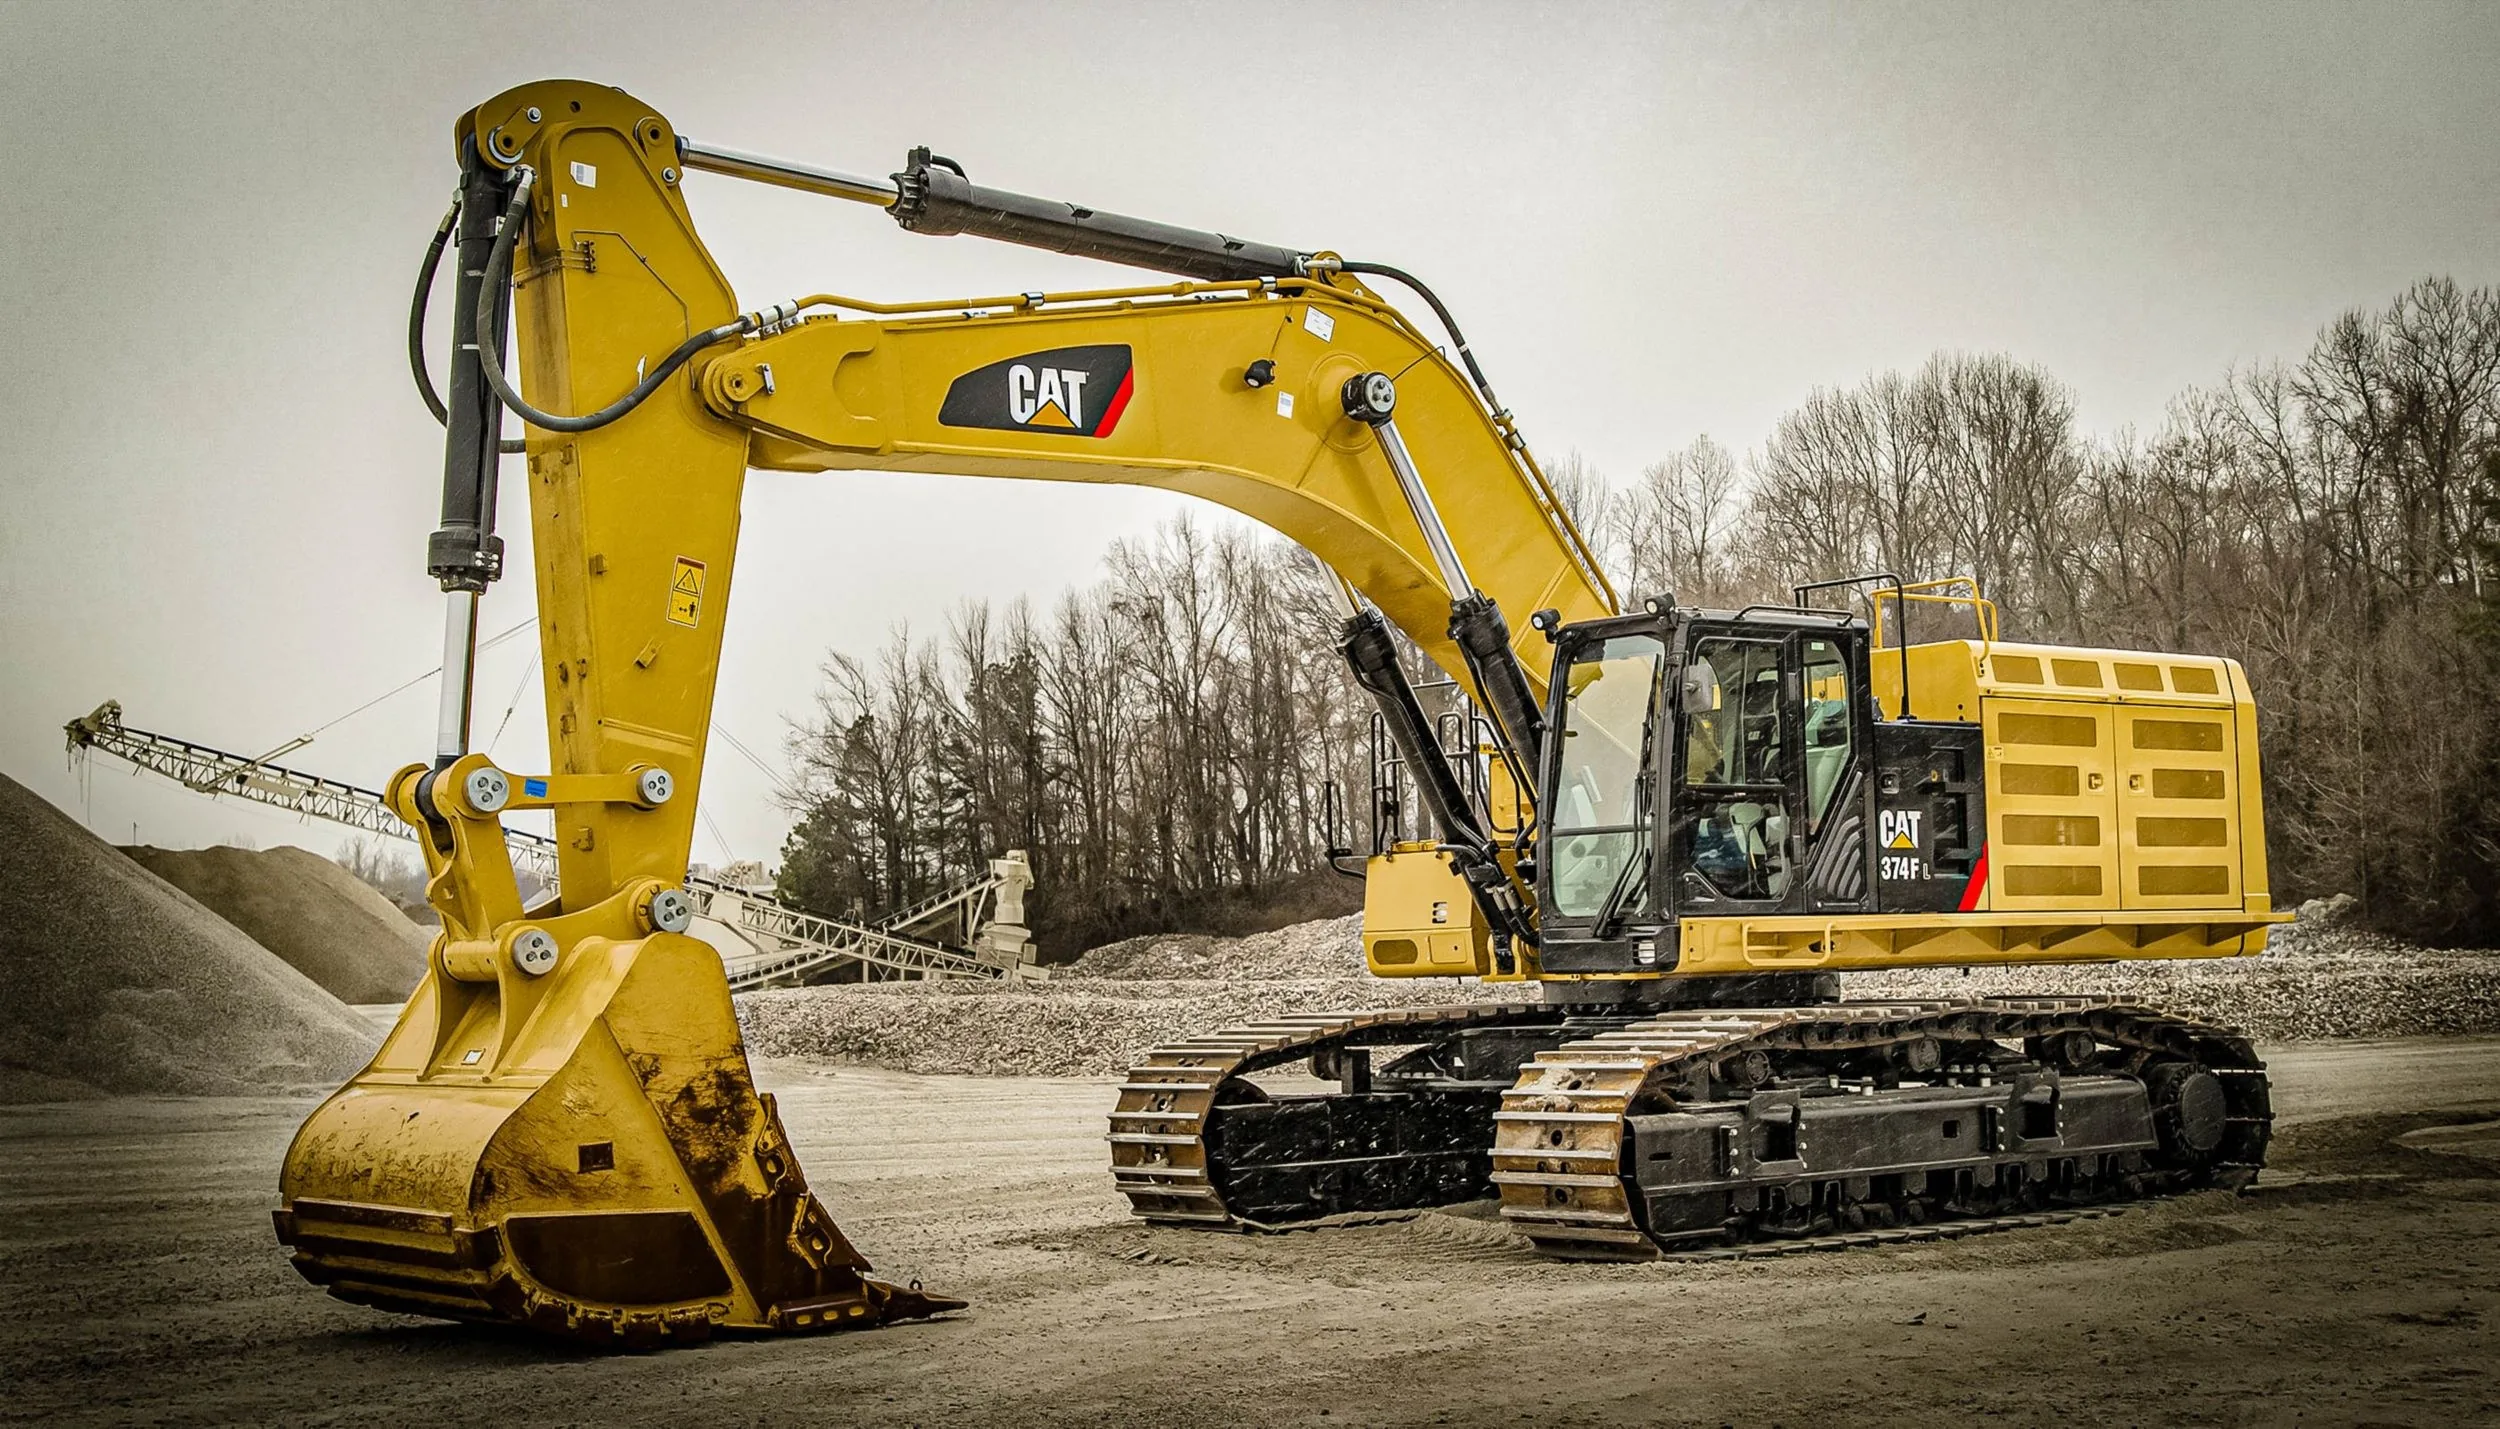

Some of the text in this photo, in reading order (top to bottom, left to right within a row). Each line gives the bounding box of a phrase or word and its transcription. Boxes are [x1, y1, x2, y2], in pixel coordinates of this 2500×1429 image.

[1008, 364, 1087, 428] CAT
[1879, 809, 1922, 849] CAT
[1881, 856, 1931, 880] 374F L
